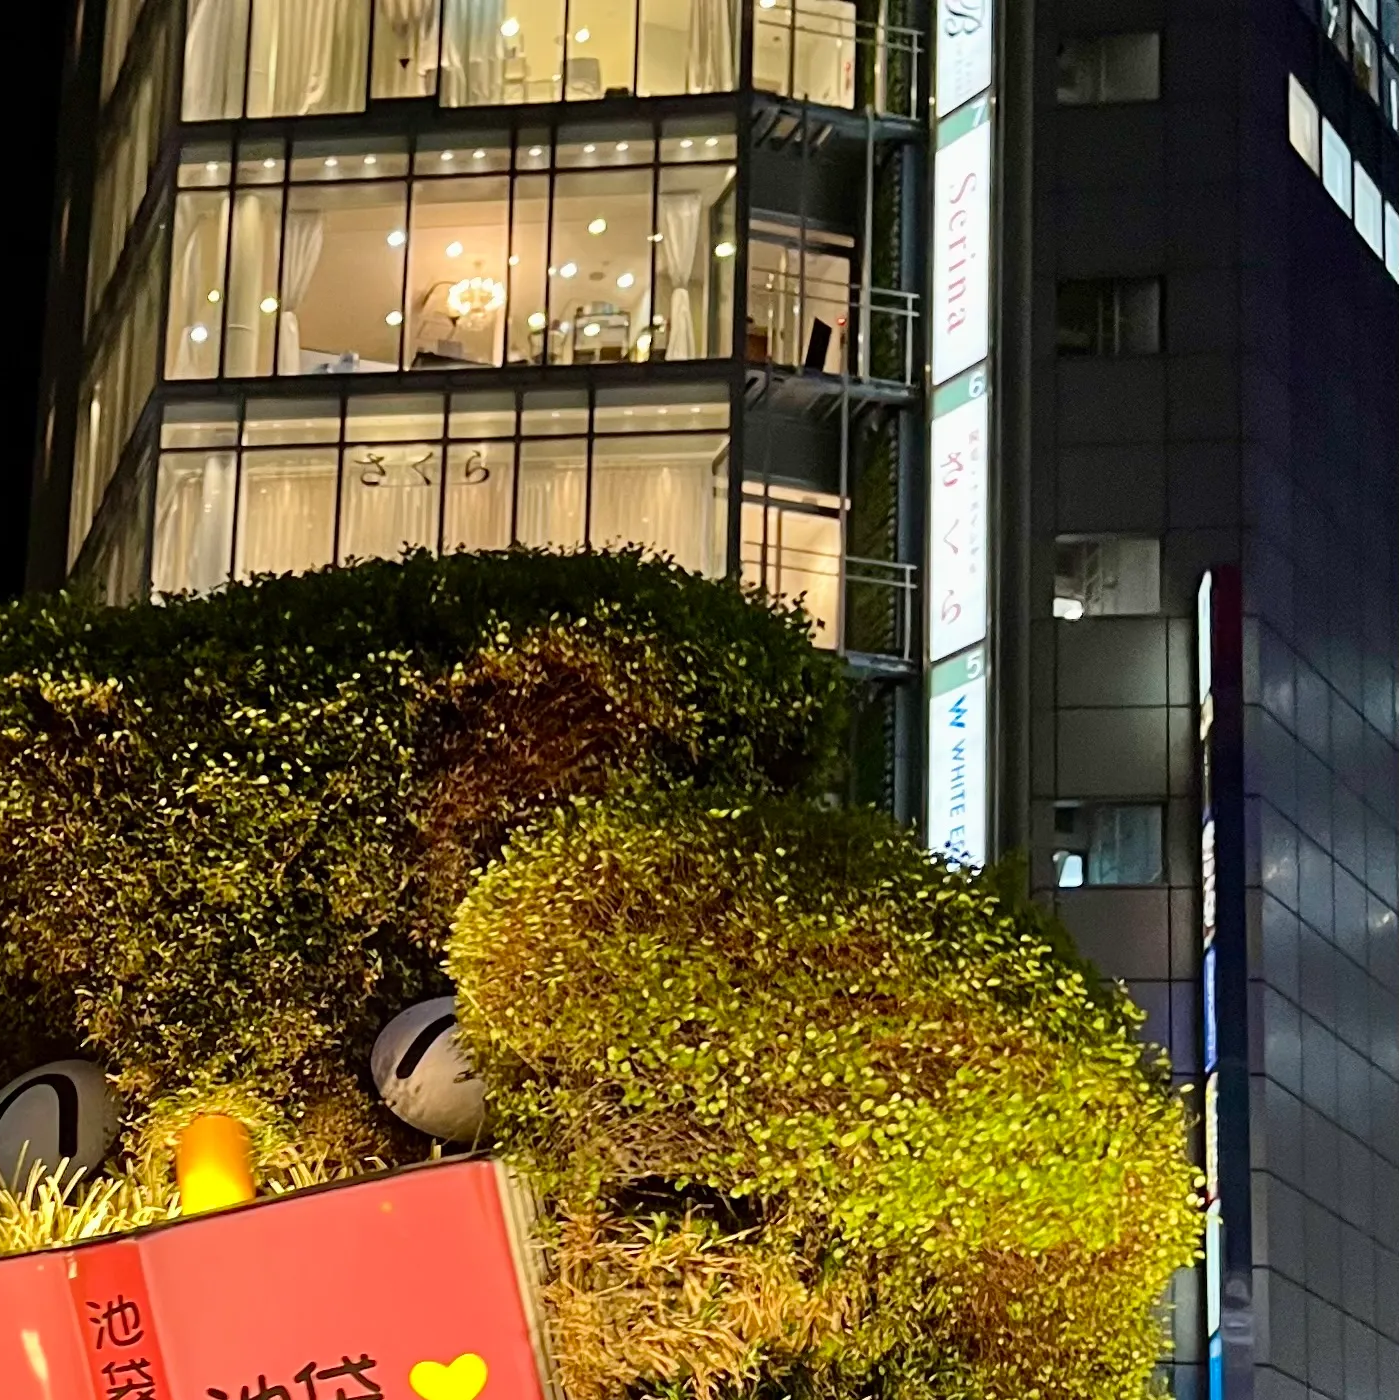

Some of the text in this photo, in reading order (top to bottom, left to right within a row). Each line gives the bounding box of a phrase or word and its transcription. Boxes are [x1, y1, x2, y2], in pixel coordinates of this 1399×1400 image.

[971, 97, 986, 127] 7
[946, 170, 977, 338] Serina
[968, 372, 985, 399] 6
[353, 449, 491, 487] さくら
[939, 451, 965, 625] さくら
[966, 654, 982, 680] 5
[950, 738, 966, 818] WHITE
